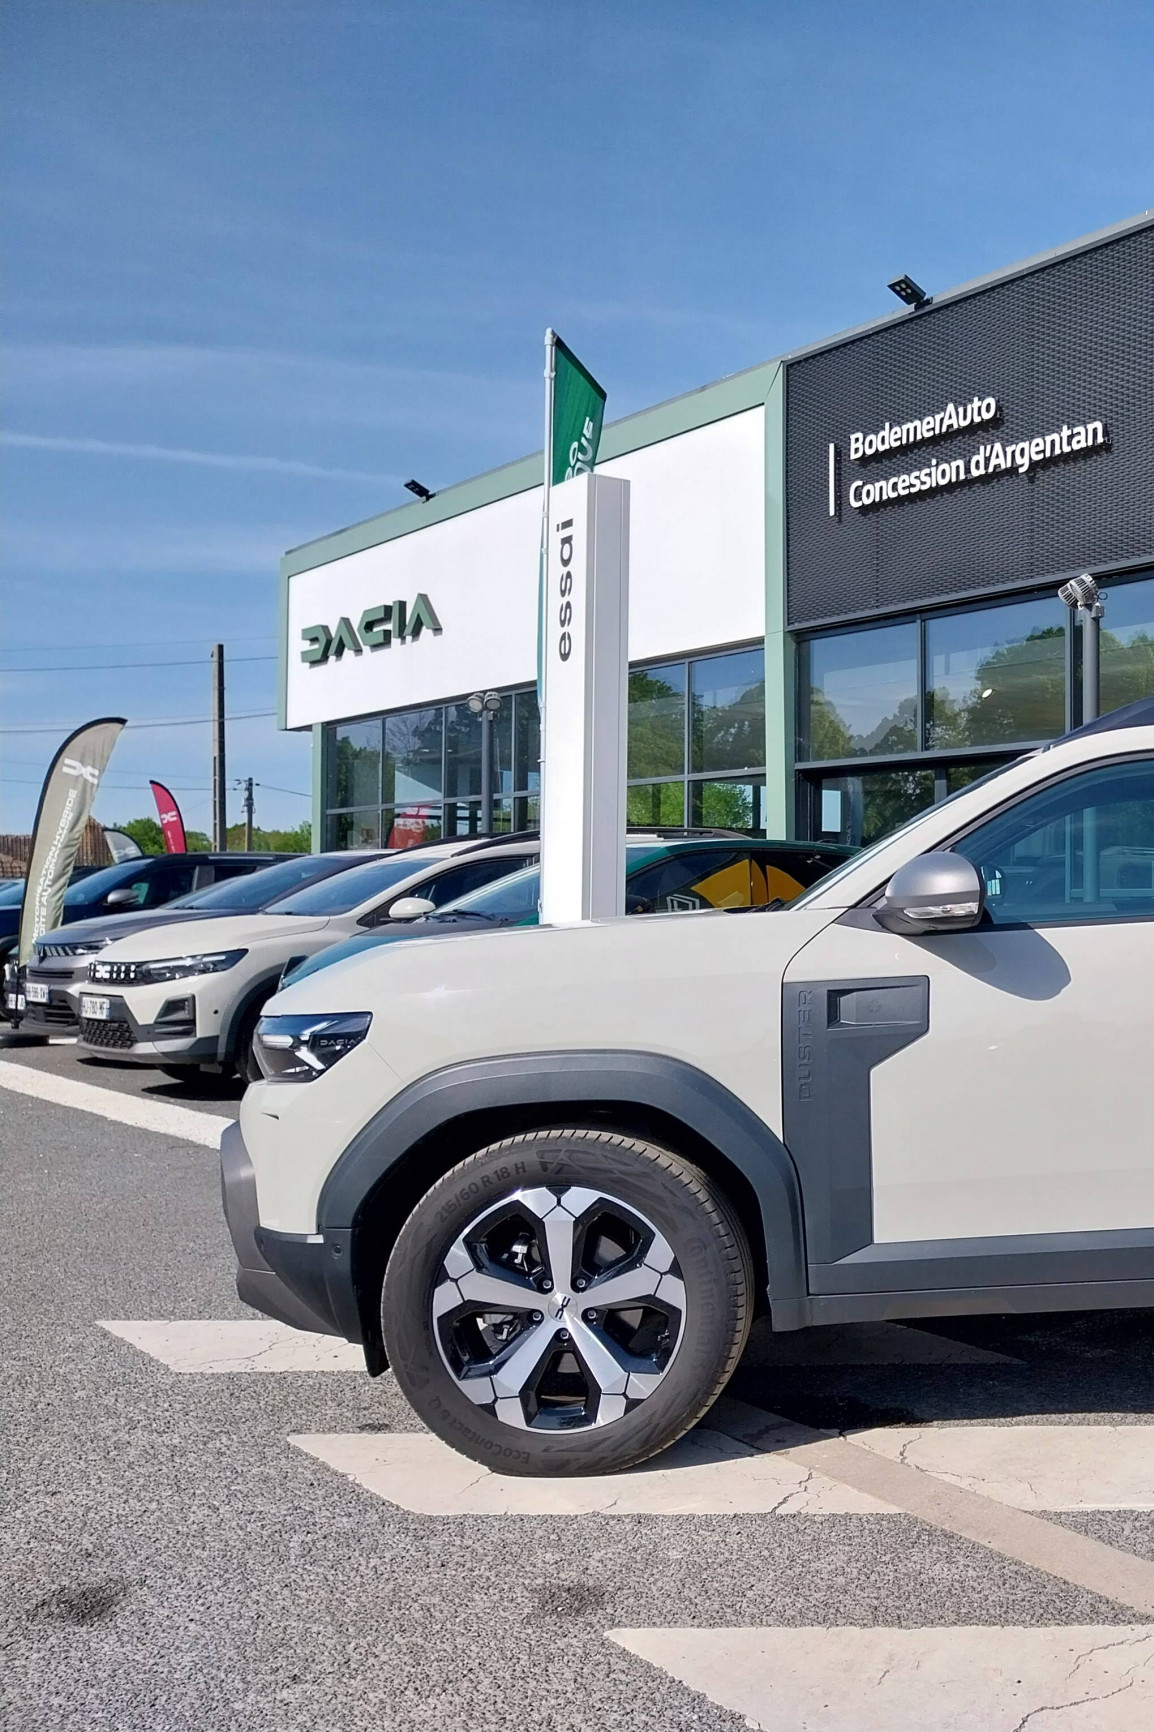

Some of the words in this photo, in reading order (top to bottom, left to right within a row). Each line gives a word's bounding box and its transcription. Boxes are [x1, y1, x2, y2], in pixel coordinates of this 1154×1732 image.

[850, 396, 997, 460] BodemerAuto
[849, 459, 966, 509] Concession
[970, 420, 1105, 474] d'Argentan
[556, 518, 574, 662] essai
[301, 593, 443, 665] DACIA
[53, 788, 78, 845] HYBRIDE
[797, 989, 814, 1102] DUSTER
[434, 1182, 480, 1223] 215/60
[480, 1174, 494, 1188] R
[493, 1166, 511, 1182] 18
[514, 1161, 527, 1175] H
[448, 1419, 532, 1464] EcoContact
